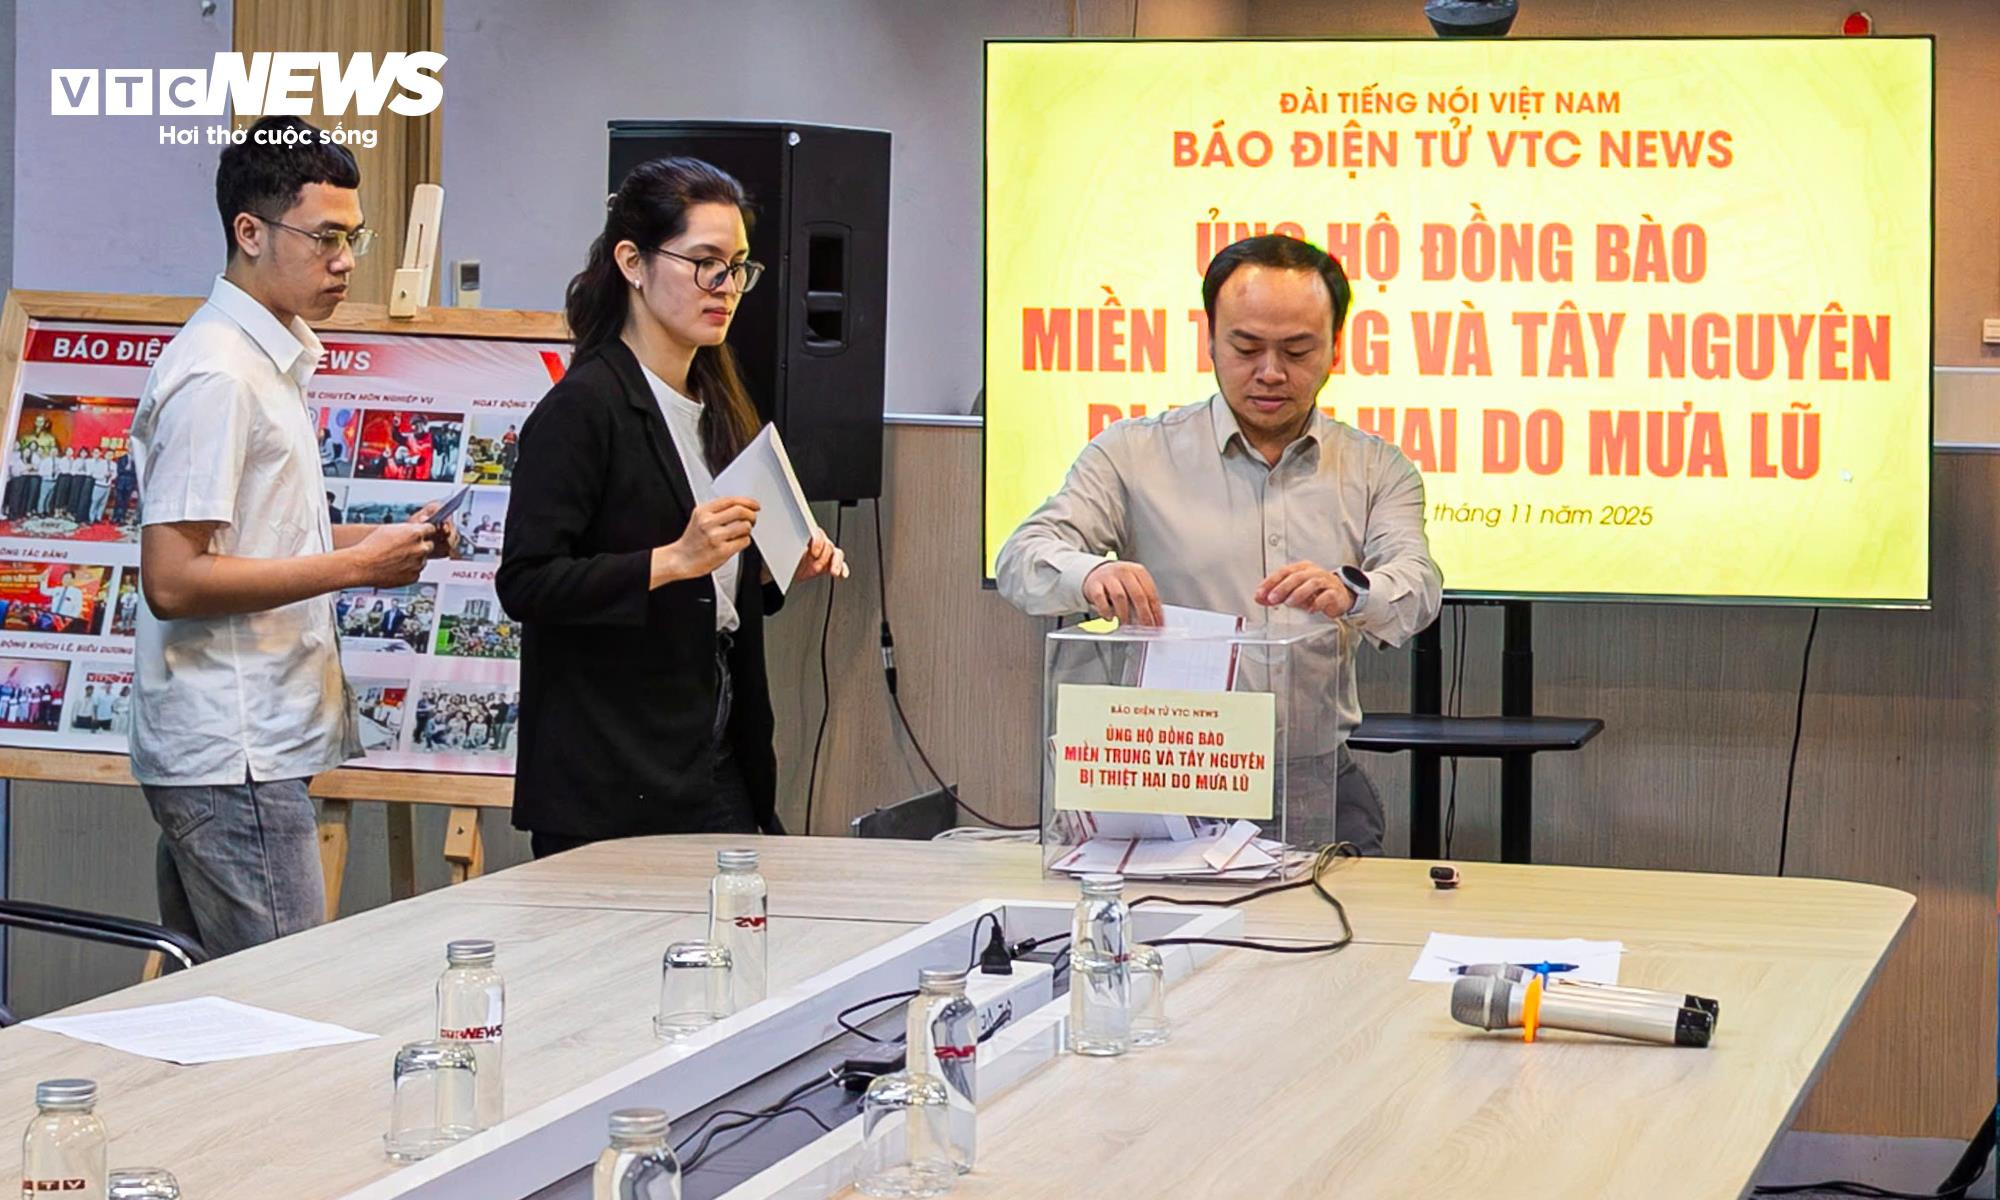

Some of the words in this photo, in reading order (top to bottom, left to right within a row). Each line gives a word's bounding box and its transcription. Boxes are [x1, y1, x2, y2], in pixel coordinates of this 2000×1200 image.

[1279, 85, 1328, 114] ĐÀI
[1337, 83, 1418, 114] TIẾNG
[1427, 85, 1479, 114] NÓI
[1489, 86, 1546, 120] VIỆT
[1555, 91, 1621, 114] NAM
[1173, 119, 1274, 168] BÁO
[1290, 120, 1399, 179] ĐIỆN
[1414, 115, 1473, 168] TỬ
[1487, 130, 1582, 168] VTC
[1600, 130, 1734, 169] NEWS
[1327, 211, 1399, 293] HỘ
[1420, 203, 1574, 283] ĐỒNG
[1595, 213, 1708, 284] BÀO
[1022, 285, 1167, 373] MIỀN
[1410, 300, 1493, 377] VÀ
[1511, 299, 1627, 379] TÂY
[1647, 302, 1891, 382] NGUYÊN
[53, 334, 109, 360] BÁO
[116, 338, 168, 366] ĐIỆ
[315, 350, 372, 371] EWS
[1481, 408, 1565, 476] DO
[1588, 401, 1729, 479] MƯA
[1749, 402, 1822, 480] LŨ
[1432, 503, 1501, 528] tháng
[1510, 504, 1532, 525] 11
[1540, 504, 1593, 526] năm
[1600, 505, 1655, 527] 2025
[1110, 704, 1131, 715] BÁO
[1134, 705, 1156, 717] ĐIỆN
[1157, 704, 1170, 717] TỬ
[1172, 709, 1190, 718] VTC
[1192, 709, 1220, 719] NEWS
[1105, 724, 1133, 743] ỦNG
[1136, 726, 1154, 746] HỘ
[1158, 725, 1194, 746] ĐỒNG
[1198, 730, 1225, 747] BÀO
[1064, 741, 1099, 763] MIỀN
[1104, 747, 1151, 766] TRUNG
[1156, 746, 1175, 767] VÀ
[1179, 748, 1206, 769] TÂY
[1210, 751, 1266, 770] NGUYÊN
[1079, 768, 1095, 788] BỊ
[1099, 767, 1138, 790] THIỆT
[1142, 772, 1166, 792] HẠI
[1171, 774, 1191, 789] DO
[1195, 772, 1228, 791] MƯA
[1232, 774, 1251, 792] LŨ
